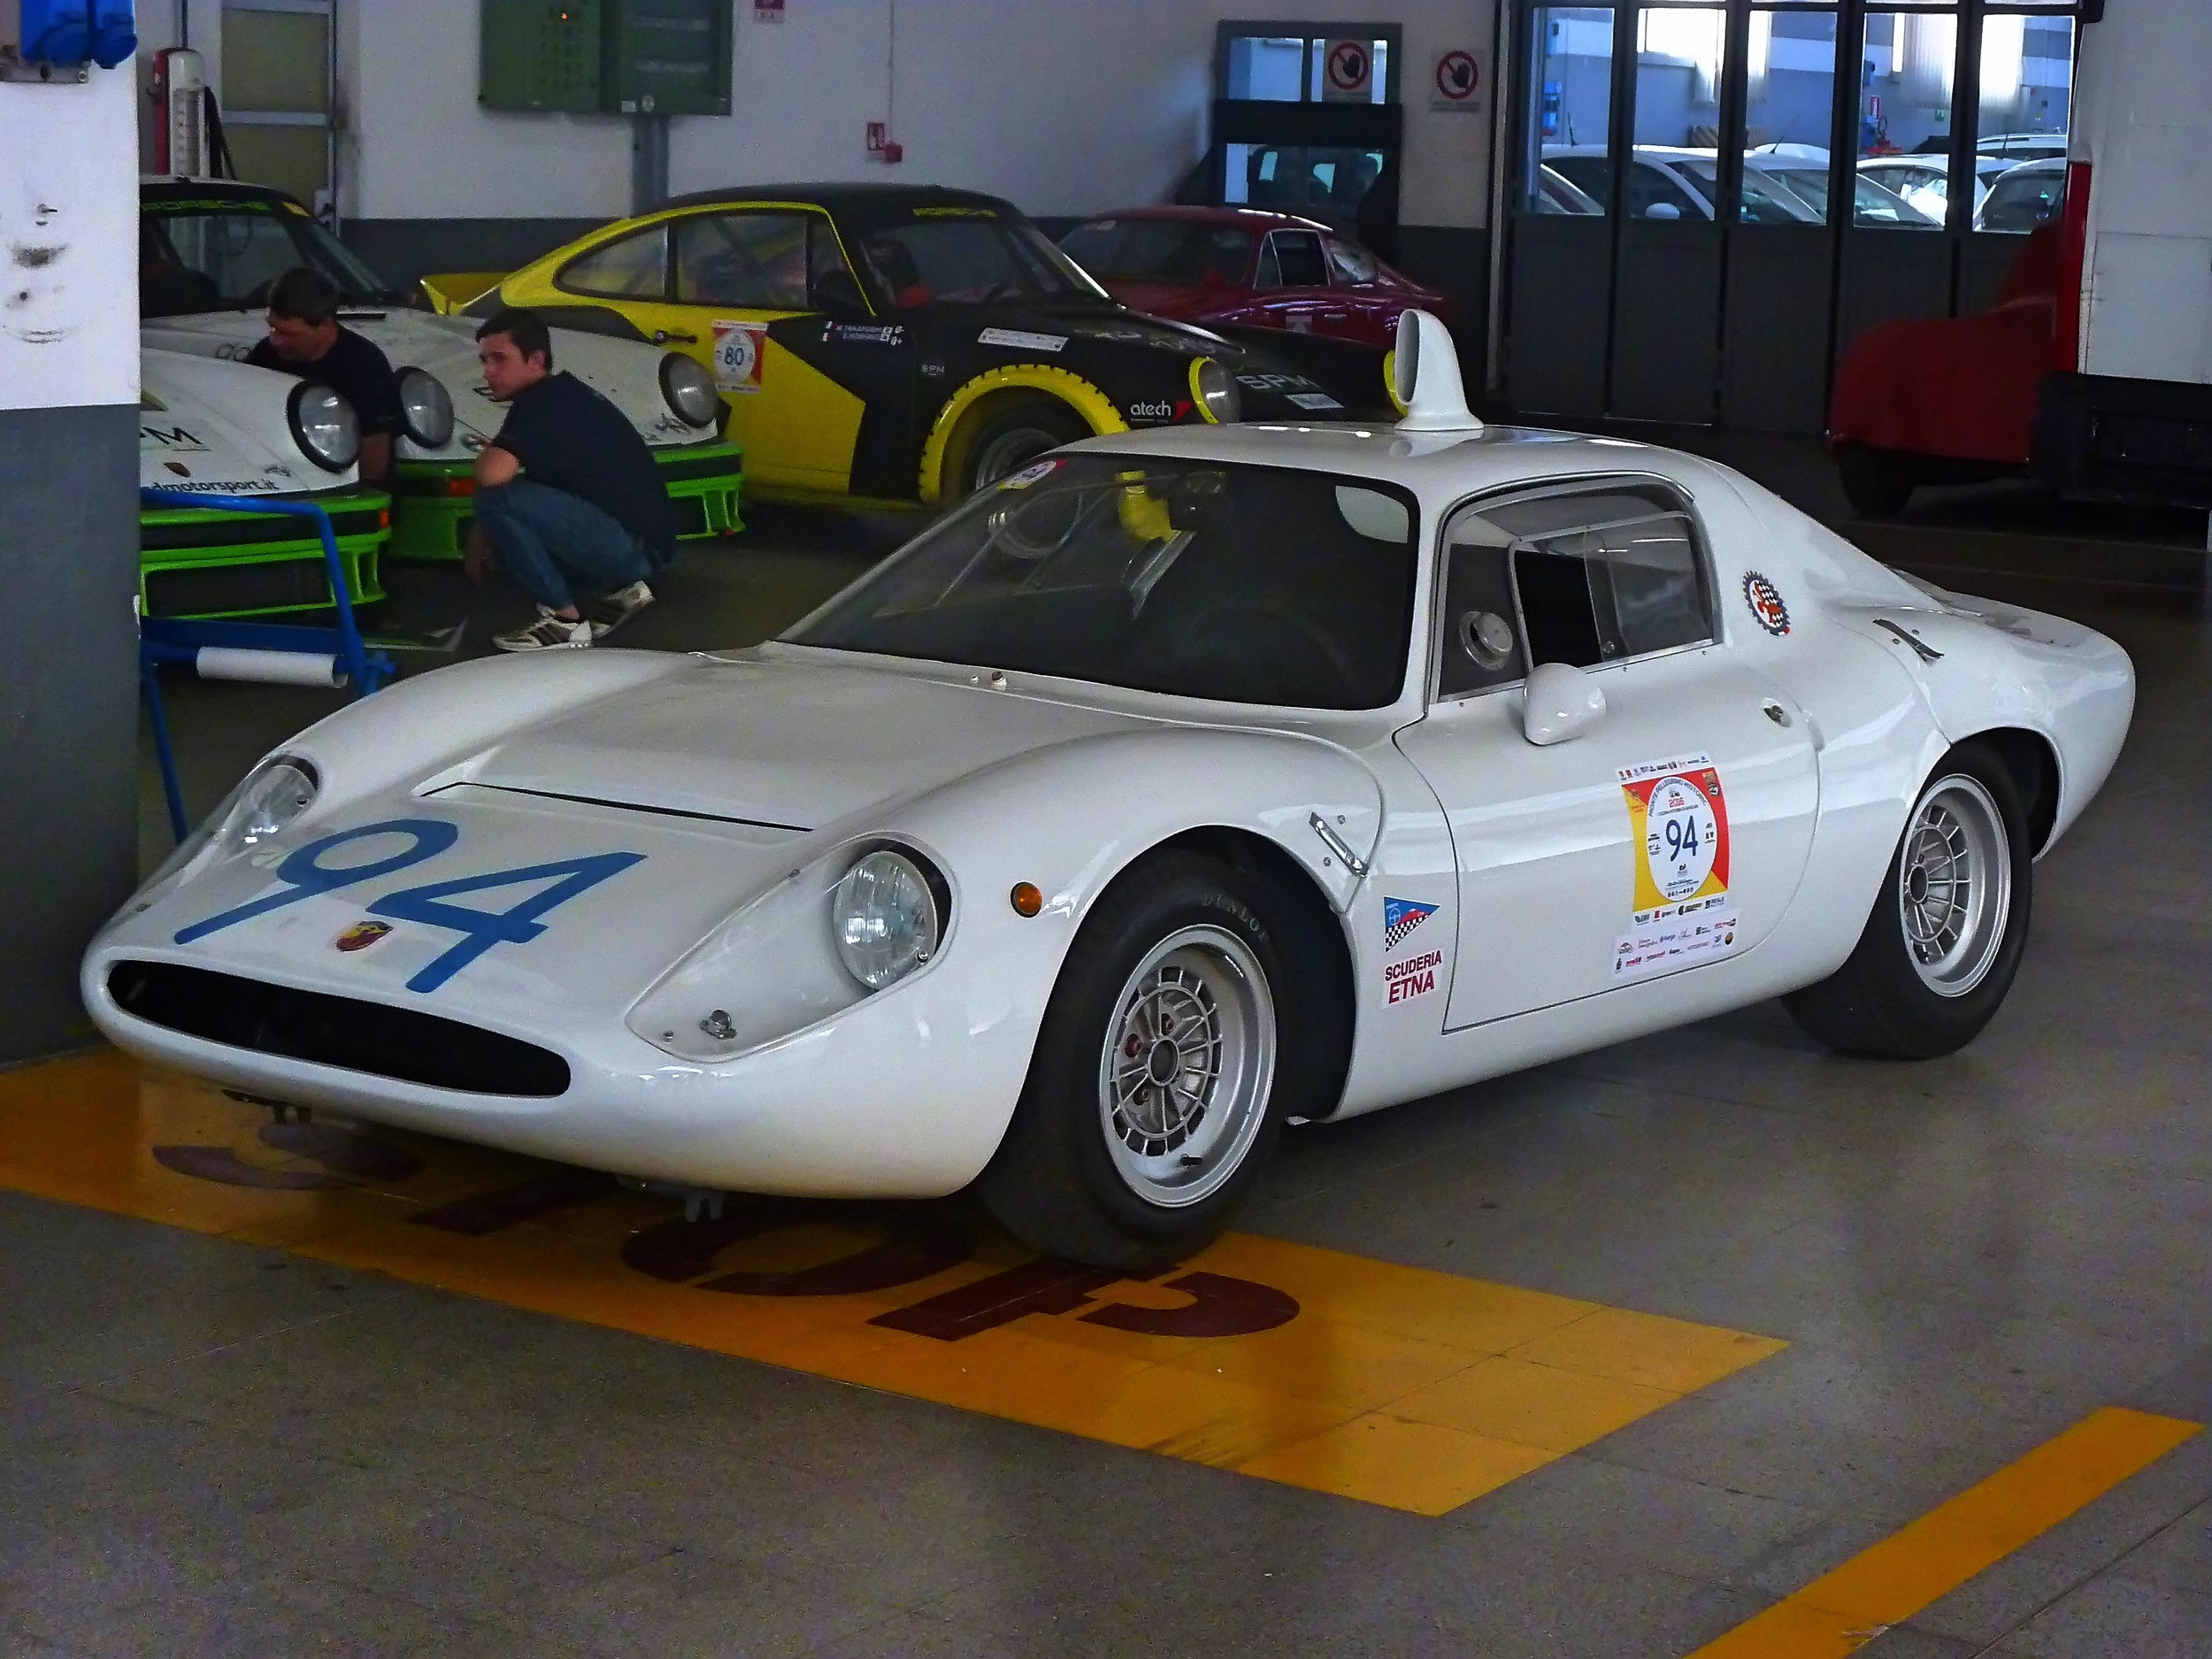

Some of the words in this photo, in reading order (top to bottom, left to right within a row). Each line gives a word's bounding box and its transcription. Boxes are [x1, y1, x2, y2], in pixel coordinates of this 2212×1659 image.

[724, 346, 744, 365] 80
[1130, 400, 1171, 416] atech
[1665, 815, 1698, 861] 94
[173, 818, 648, 994] 94
[1385, 950, 1442, 981] SCUDERIA
[1388, 970, 1435, 1004] ETNA
